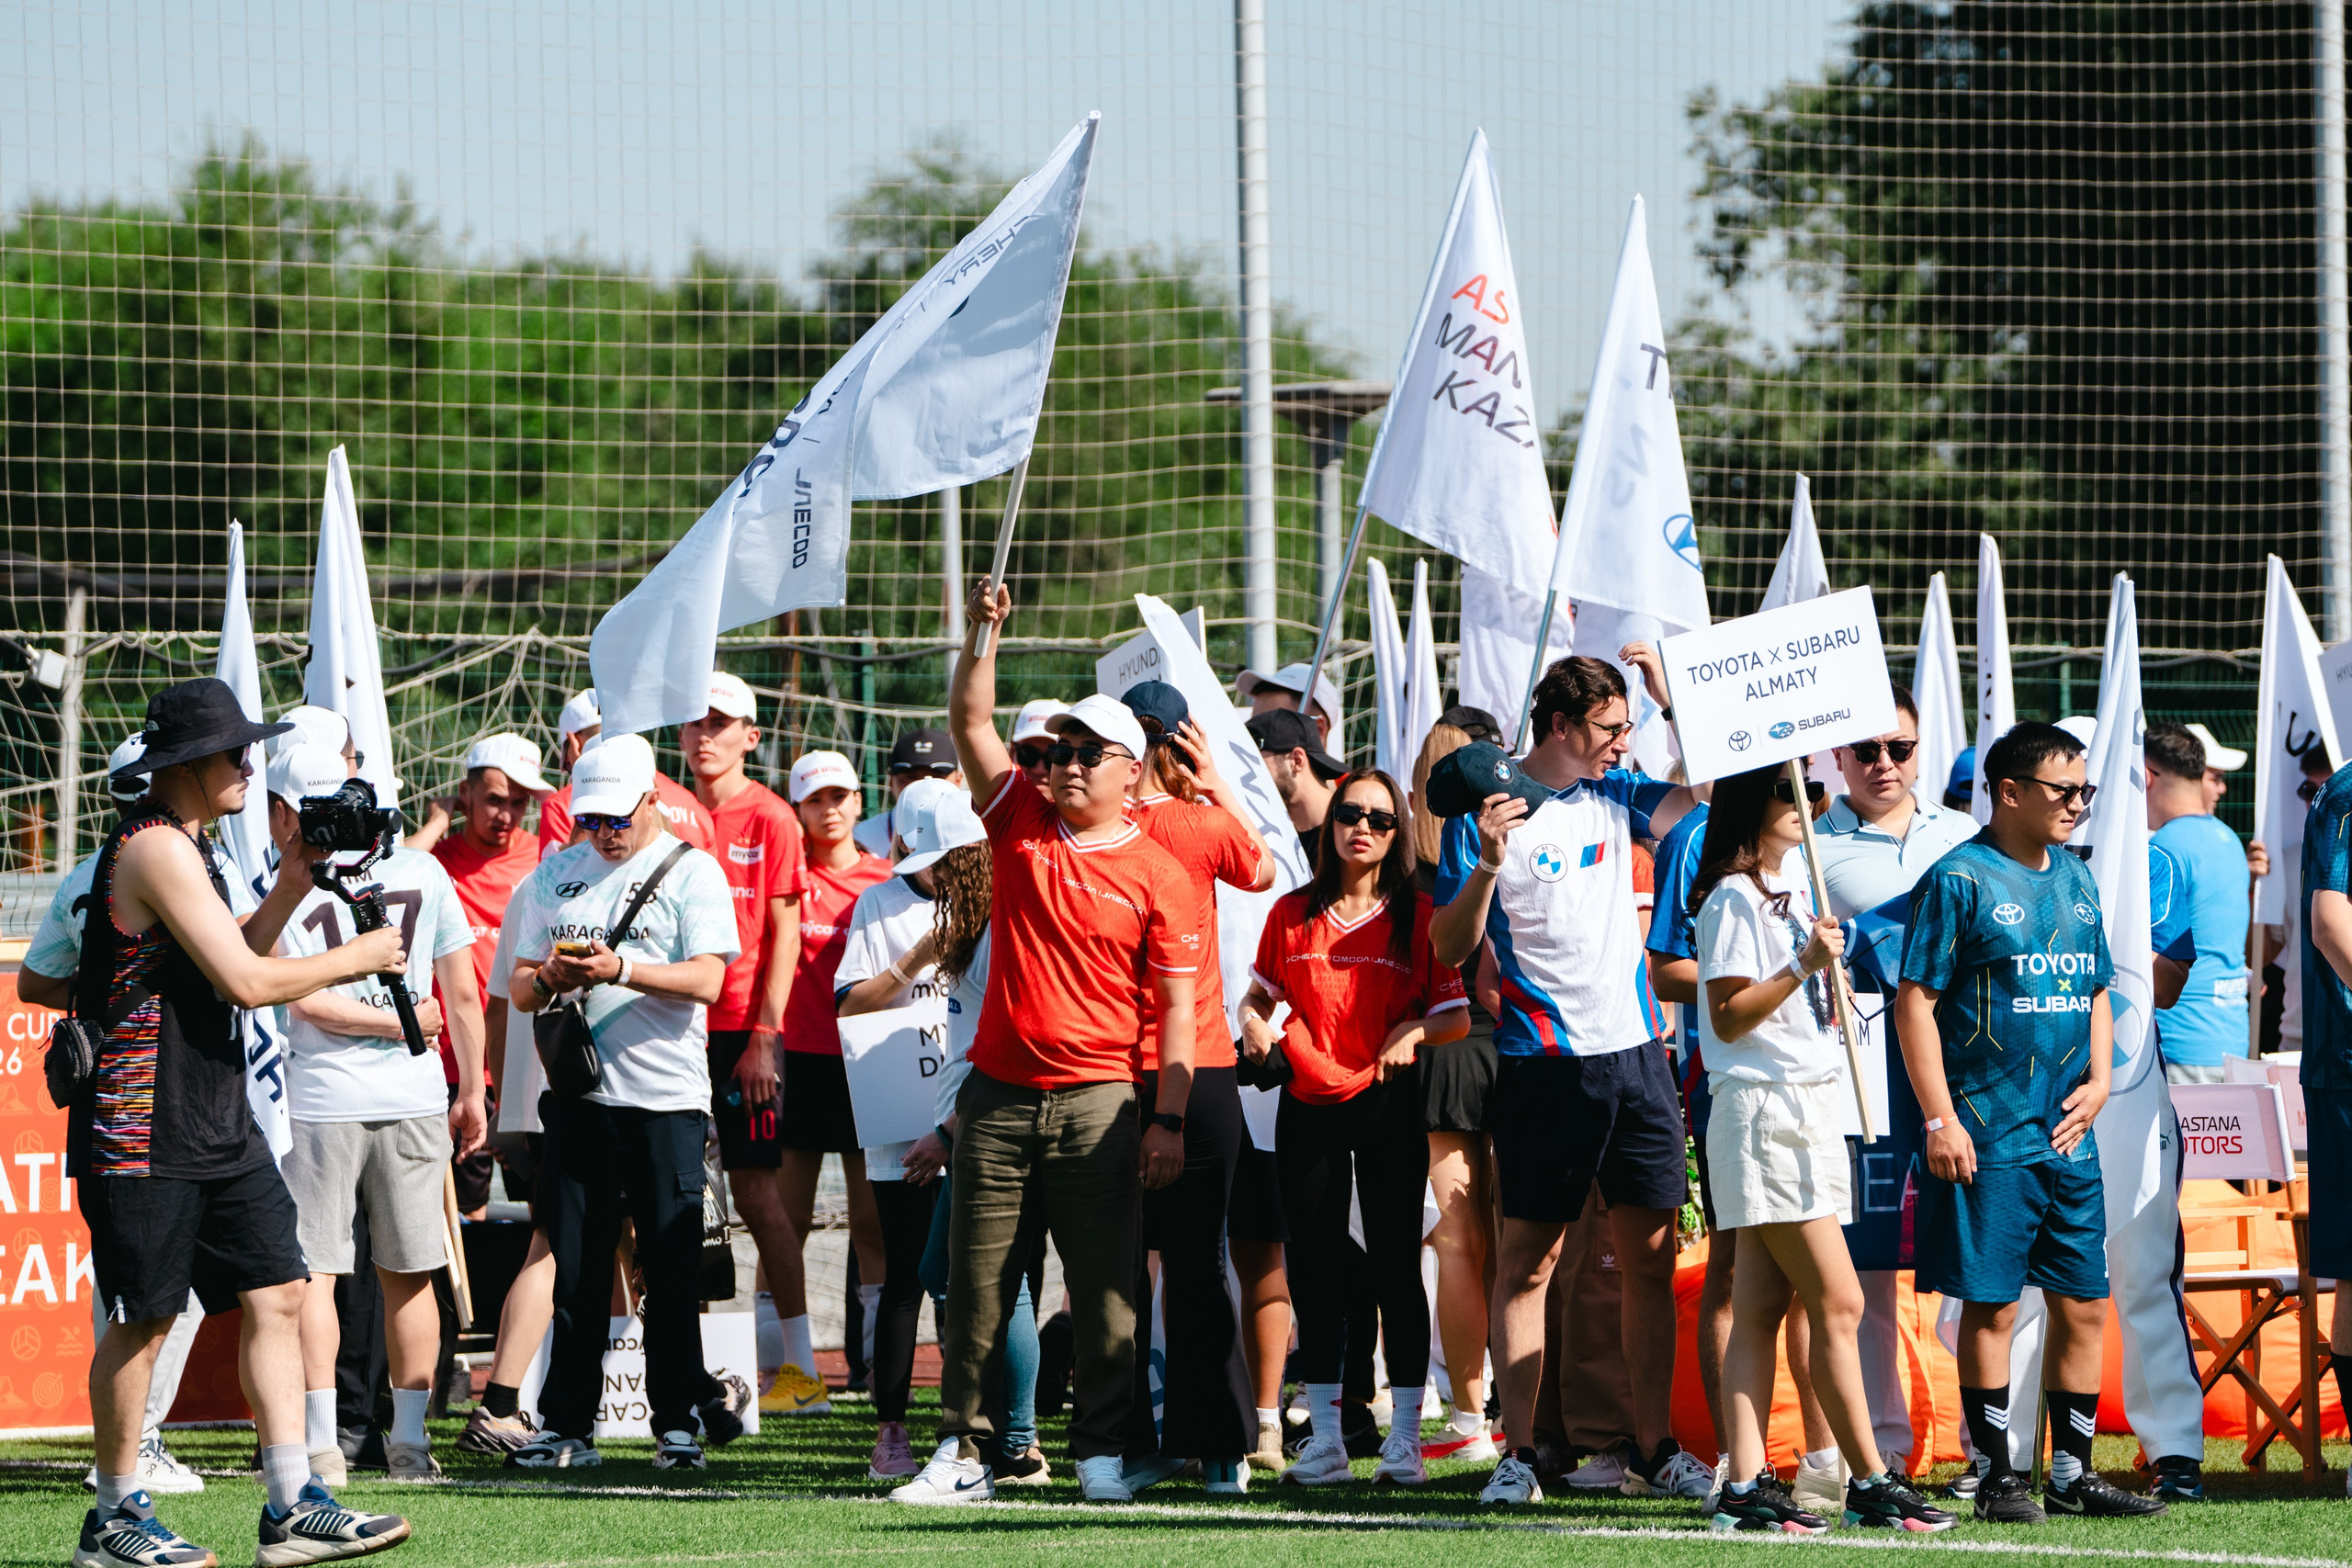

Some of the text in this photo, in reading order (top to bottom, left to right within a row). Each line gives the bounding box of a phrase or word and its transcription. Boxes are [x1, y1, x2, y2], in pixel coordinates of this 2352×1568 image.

[1432, 369, 1535, 449] KAZ
[1118, 647, 1161, 685] HYUND
[1686, 650, 1764, 685] TOYOTA
[1786, 625, 1860, 660] SUBARU
[1745, 665, 1817, 702] ALMATY
[1798, 707, 1851, 731] SUBARU
[359, 843, 385, 871] RONIN
[550, 924, 651, 942] KARAGADA
[2010, 953, 2095, 976] TOYOTA
[2181, 1115, 2241, 1132] ASTANA
[2183, 1135, 2243, 1155] TORS
